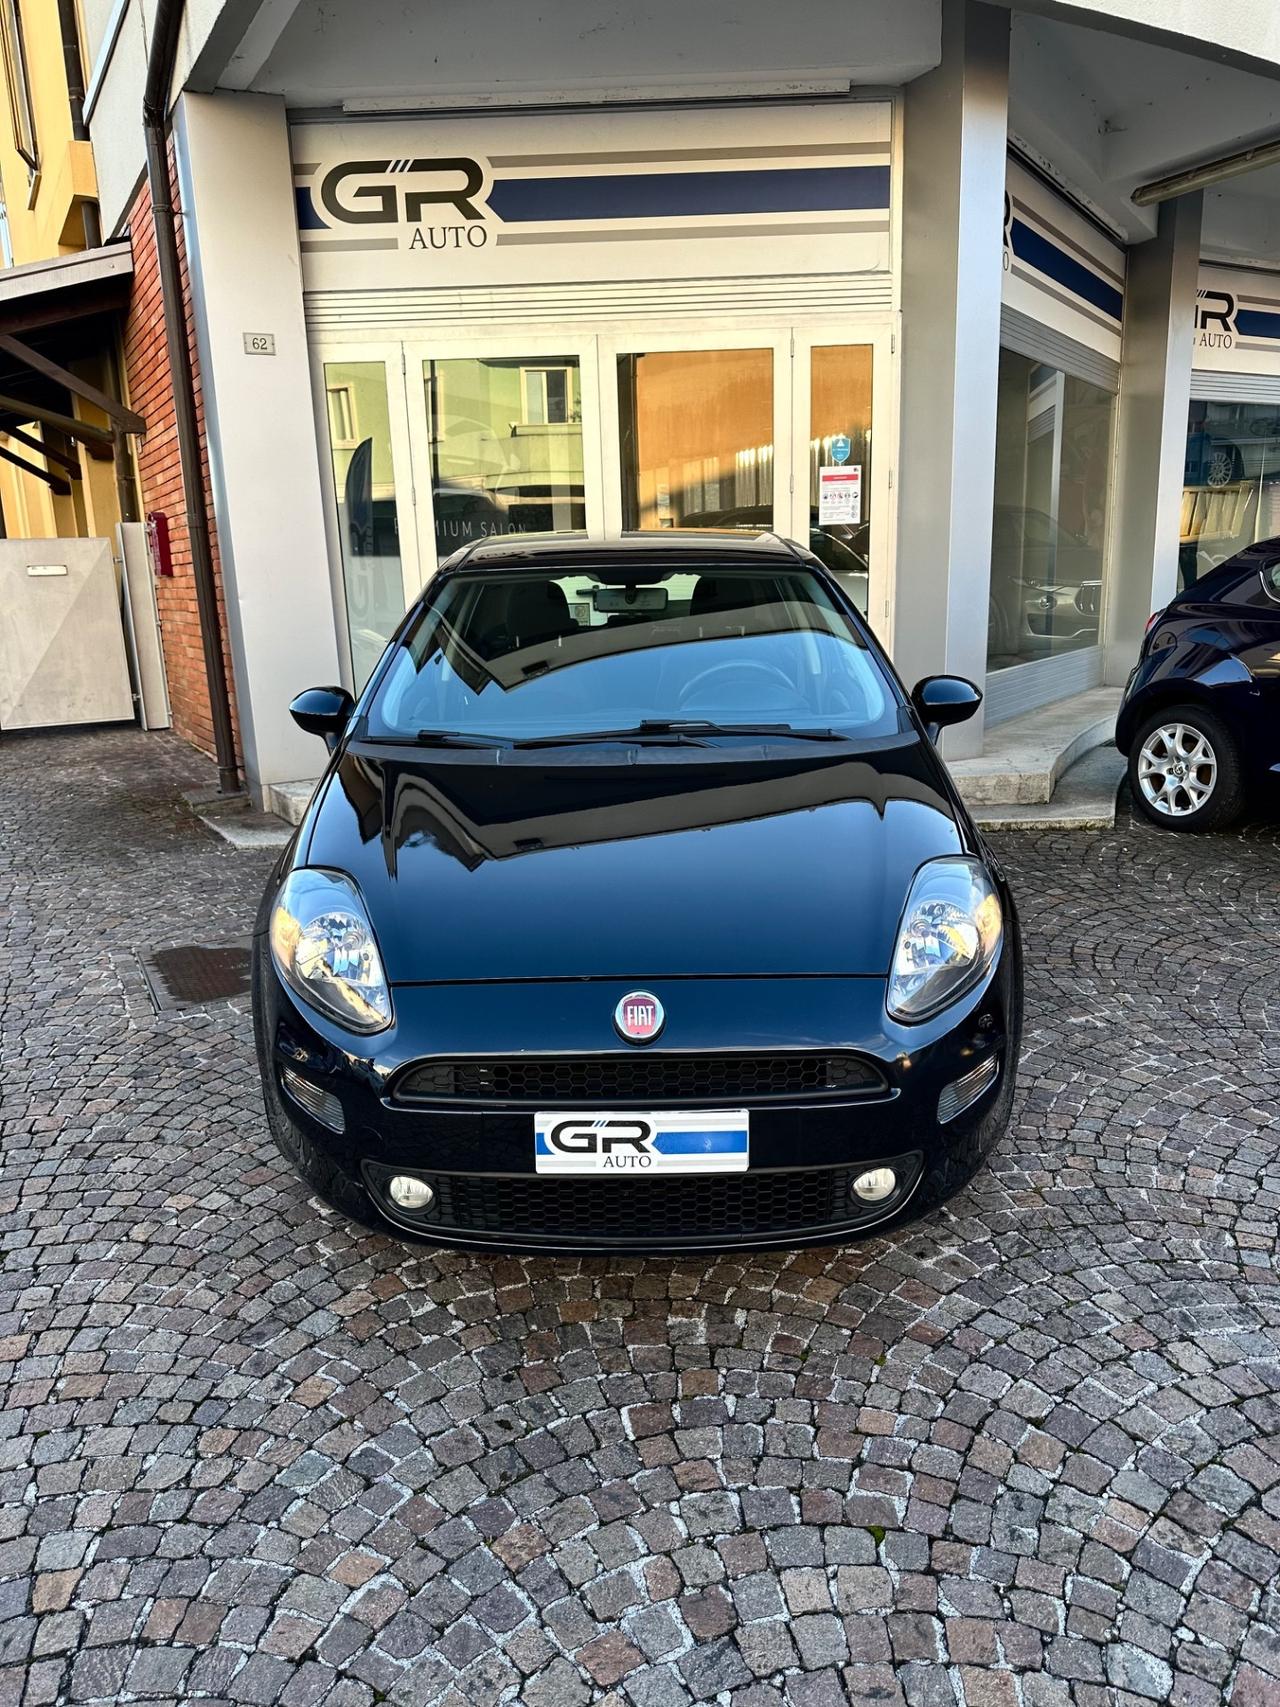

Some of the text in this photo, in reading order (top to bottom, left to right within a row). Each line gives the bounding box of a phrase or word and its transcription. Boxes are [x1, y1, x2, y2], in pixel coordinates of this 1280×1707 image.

[321, 157, 486, 224] GR
[409, 225, 487, 249] AUTO
[1194, 289, 1234, 332] R
[252, 337, 267, 350] 62
[1199, 333, 1232, 349] AUTO
[627, 1005, 654, 1026] FIAT
[550, 1120, 651, 1153] GR
[603, 1155, 651, 1168] AUTO
